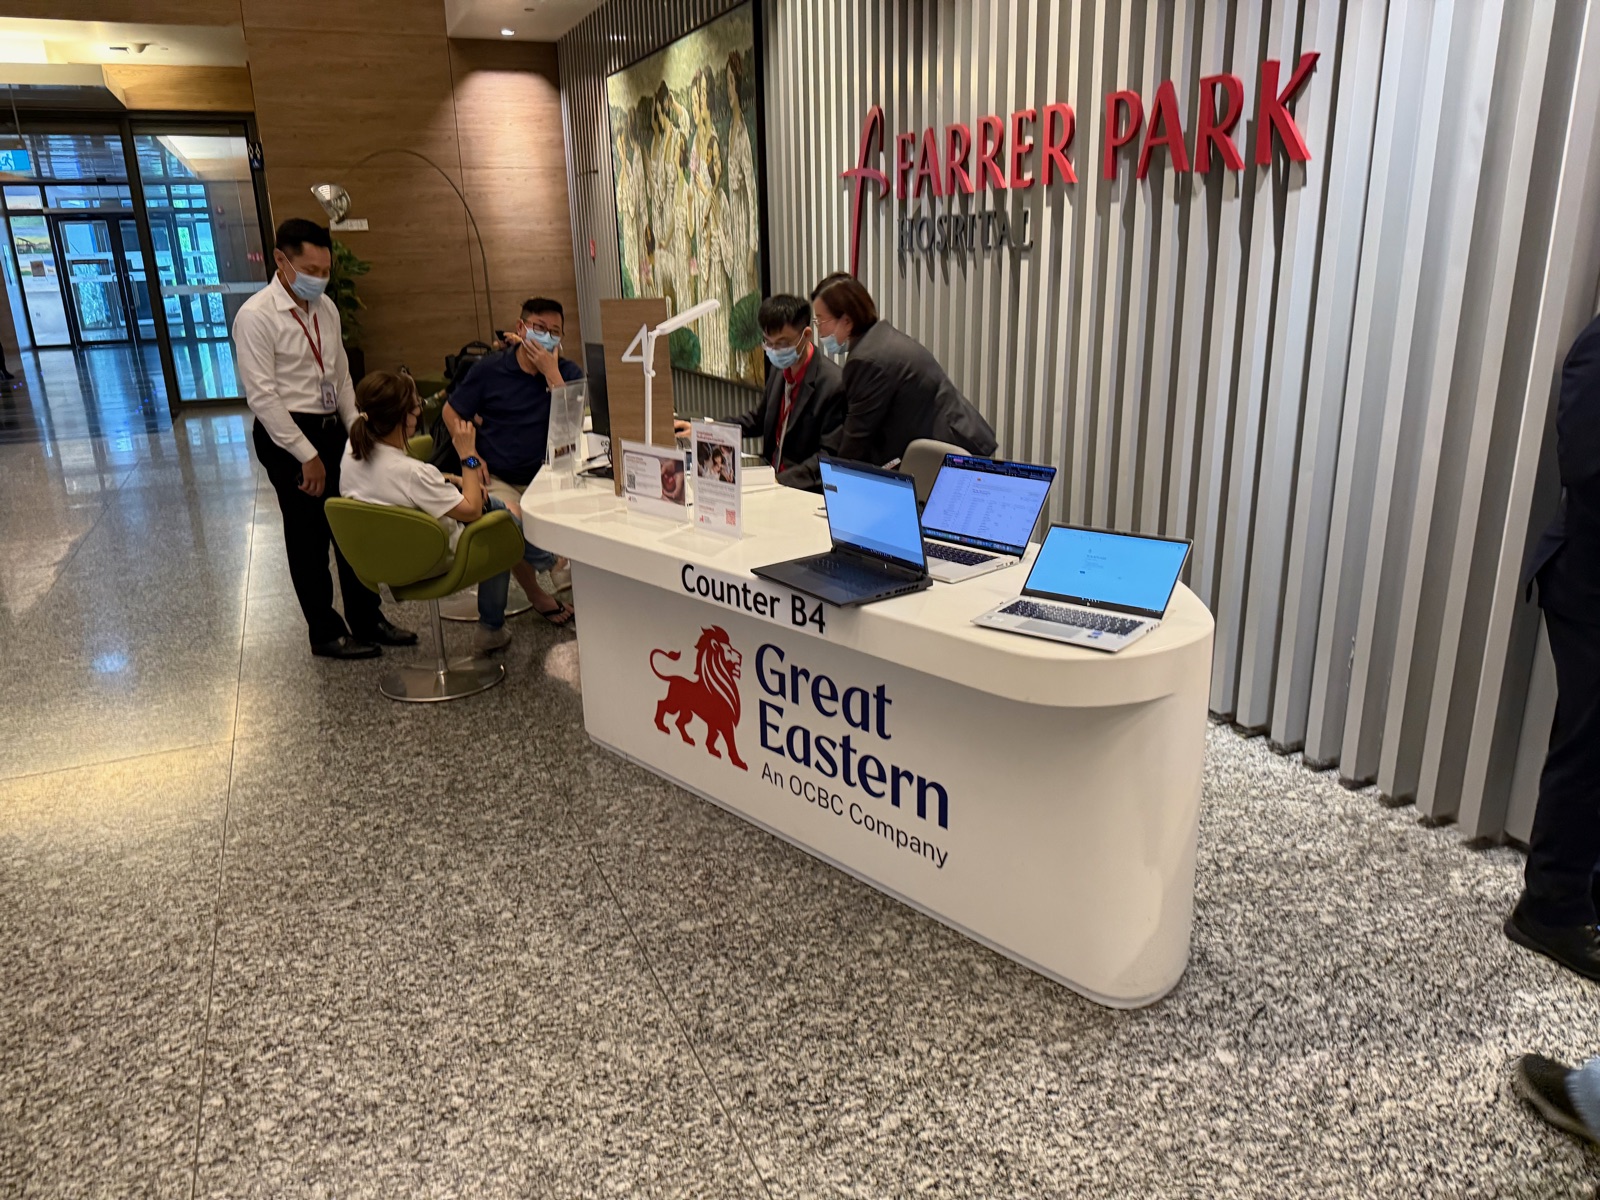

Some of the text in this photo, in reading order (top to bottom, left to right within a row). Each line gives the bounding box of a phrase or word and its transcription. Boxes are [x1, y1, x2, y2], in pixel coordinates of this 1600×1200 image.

[896, 52, 1321, 200] FARRER PARK
[897, 209, 1034, 253] HOSPITAL
[681, 563, 826, 634] Counter B4
[755, 643, 893, 740] Great
[758, 698, 949, 830] Eastern
[761, 762, 949, 869] An OCBC Company
